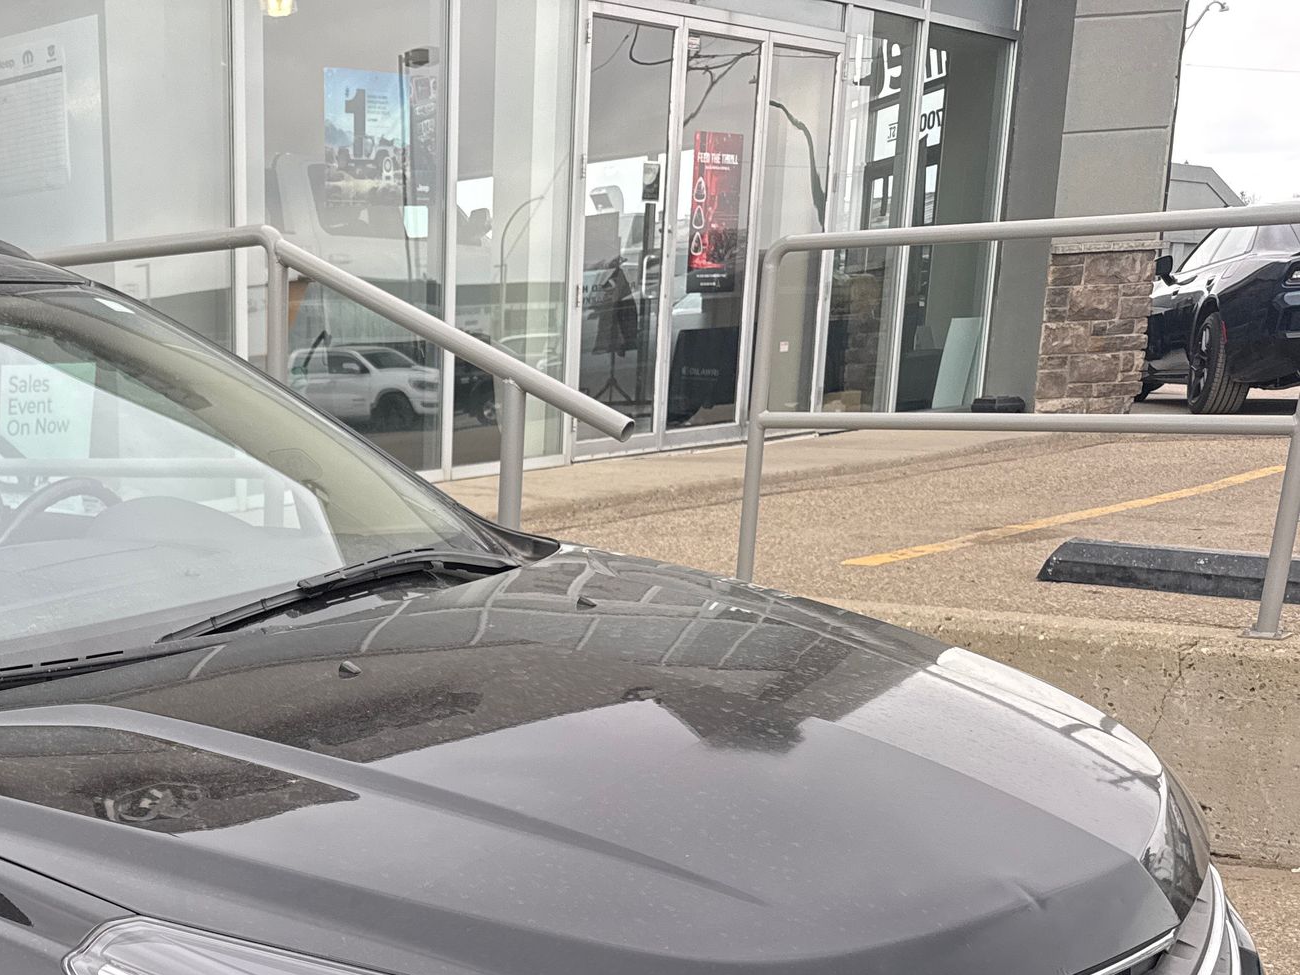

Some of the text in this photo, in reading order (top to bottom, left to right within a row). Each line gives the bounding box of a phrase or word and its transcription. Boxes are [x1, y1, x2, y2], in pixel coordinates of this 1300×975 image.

[8, 374, 50, 393] Sales
[8, 398, 53, 415] Event
[7, 417, 70, 437] On Now
